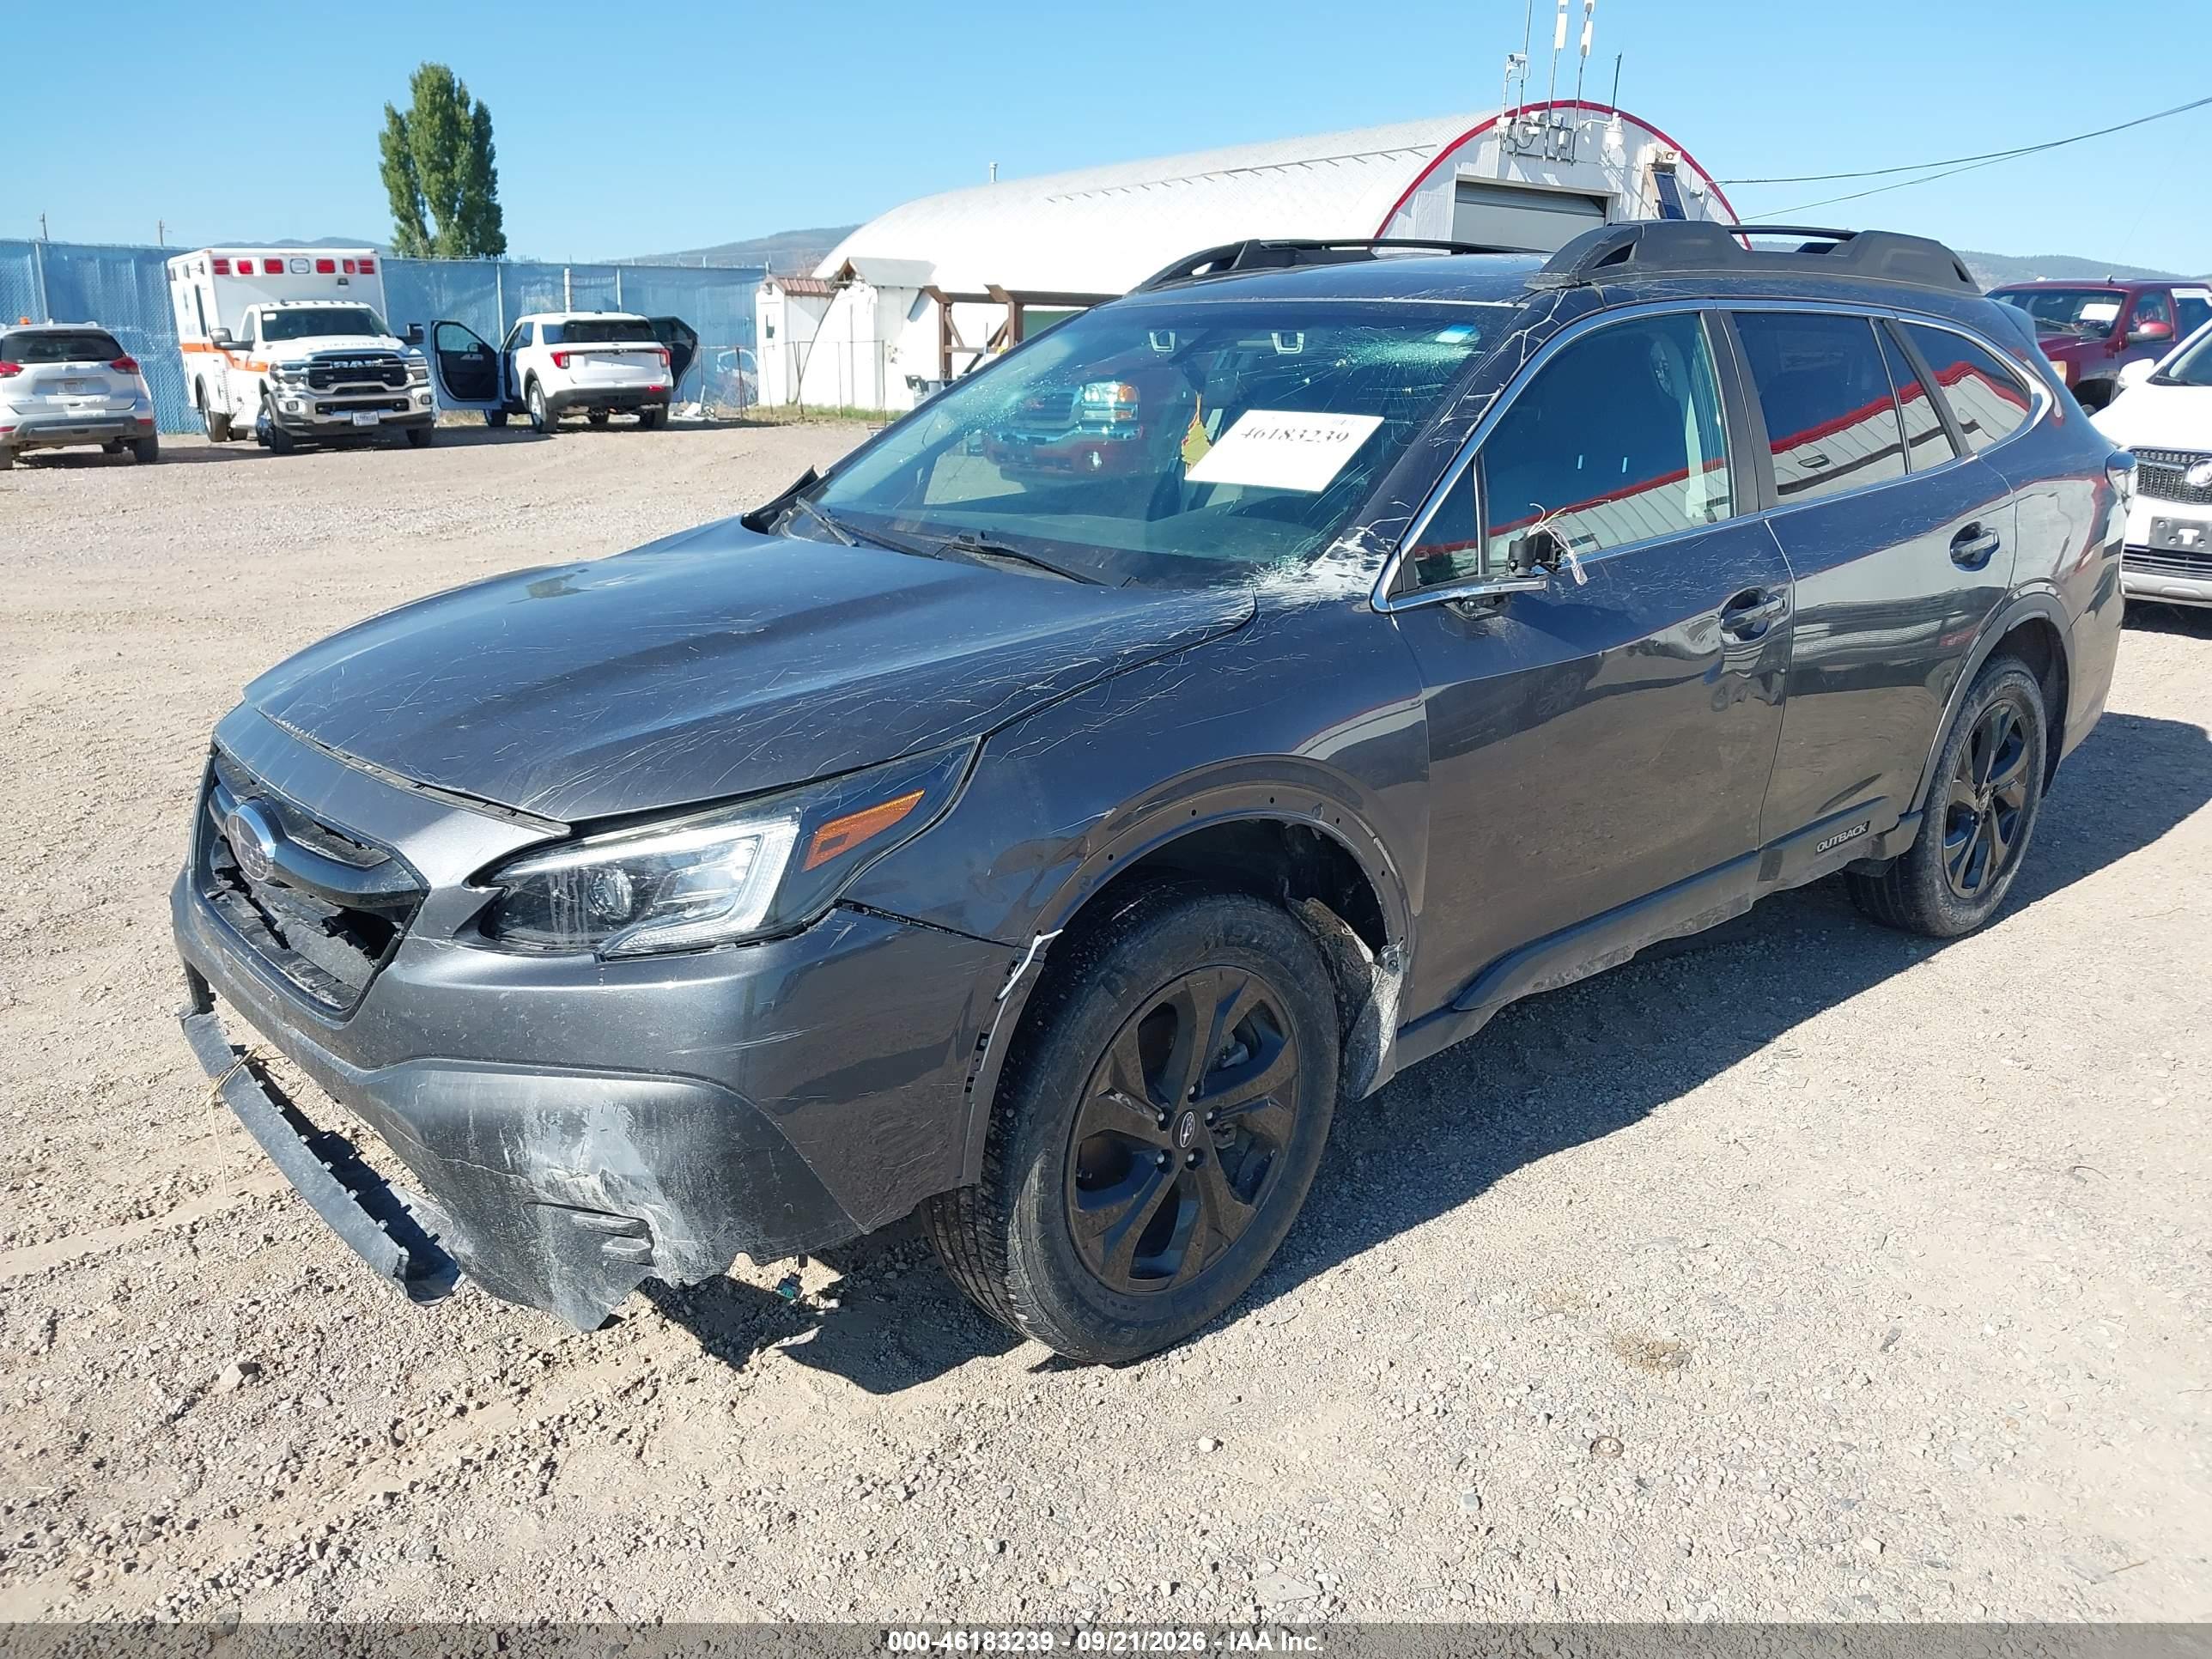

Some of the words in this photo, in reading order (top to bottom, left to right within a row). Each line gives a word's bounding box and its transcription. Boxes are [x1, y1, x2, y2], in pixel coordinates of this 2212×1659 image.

[332, 358, 383, 368] RAM
[1241, 427, 1350, 442] 46183239
[1816, 823, 1868, 852] OUTBACK
